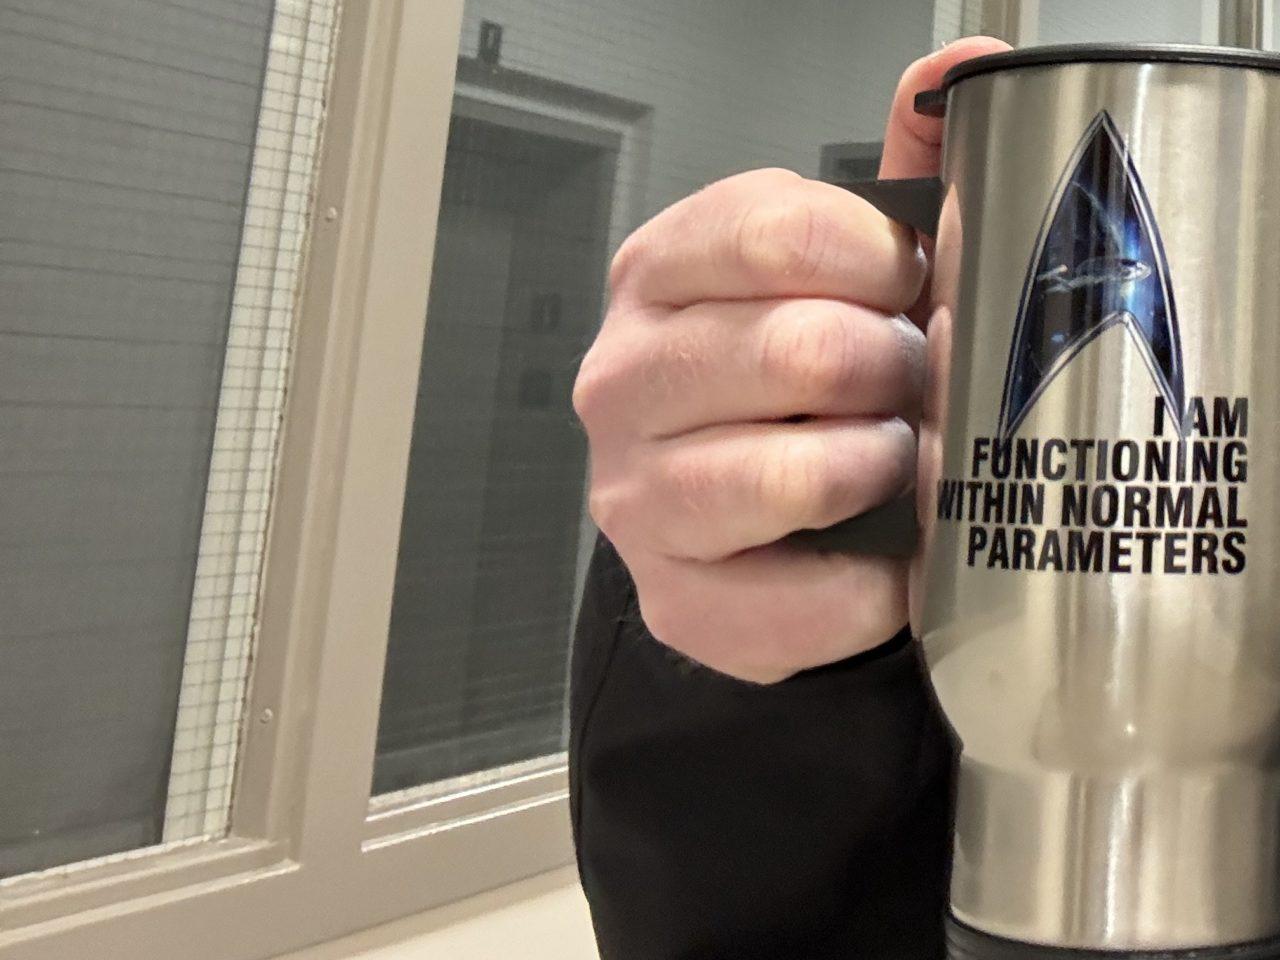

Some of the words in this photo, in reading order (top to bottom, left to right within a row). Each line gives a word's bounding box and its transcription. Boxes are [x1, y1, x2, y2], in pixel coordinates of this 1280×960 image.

[1153, 396, 1165, 437] I
[1181, 396, 1249, 438] AM
[971, 438, 1248, 482] FUNCTIONING
[937, 478, 1045, 525] WITHIN
[1061, 483, 1248, 528] NORMAL
[967, 526, 1246, 575] PARAMETERS
